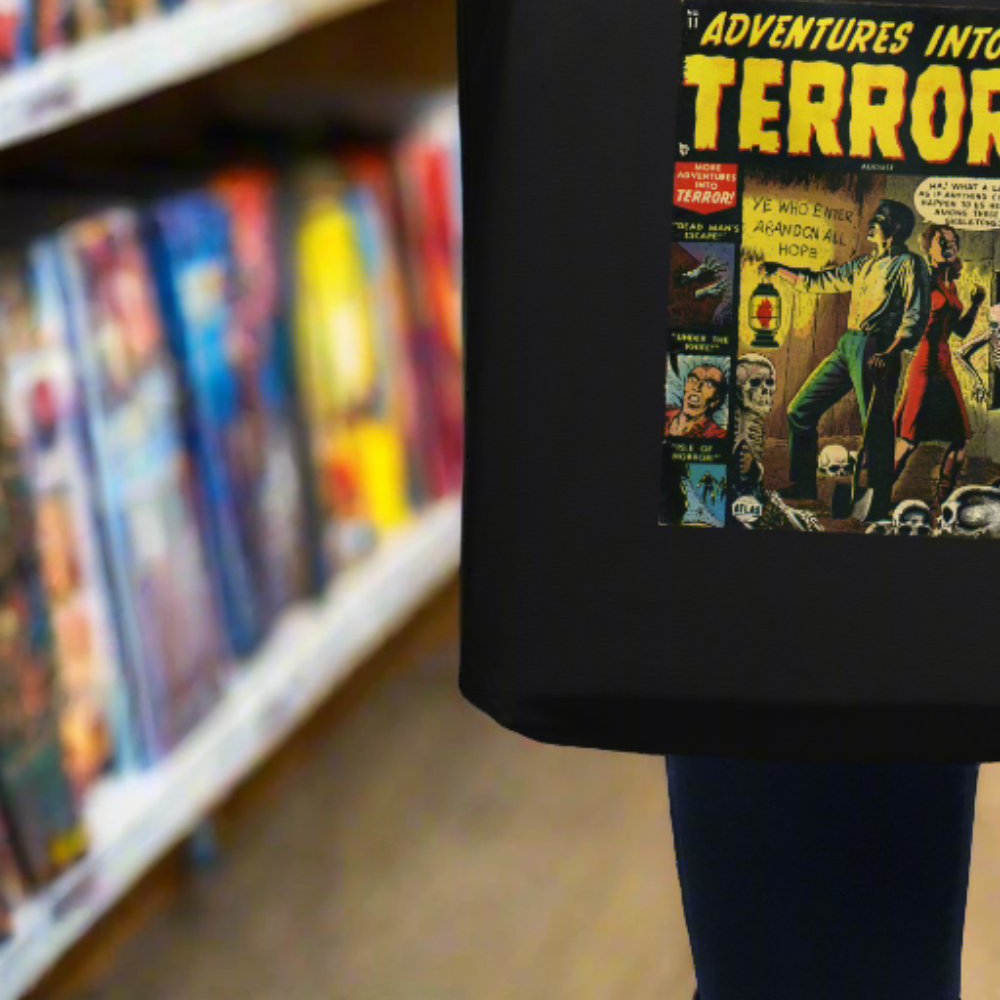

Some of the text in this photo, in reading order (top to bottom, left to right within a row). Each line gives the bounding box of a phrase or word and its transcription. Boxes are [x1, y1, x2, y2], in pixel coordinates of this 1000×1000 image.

[700, 11, 914, 55] ADVENTURES
[677, 188, 735, 206] TERROR!
[752, 194, 854, 223] YE WHO ENTER
[753, 220, 847, 247] ABANDON ALL
[778, 242, 817, 259] HOPE
